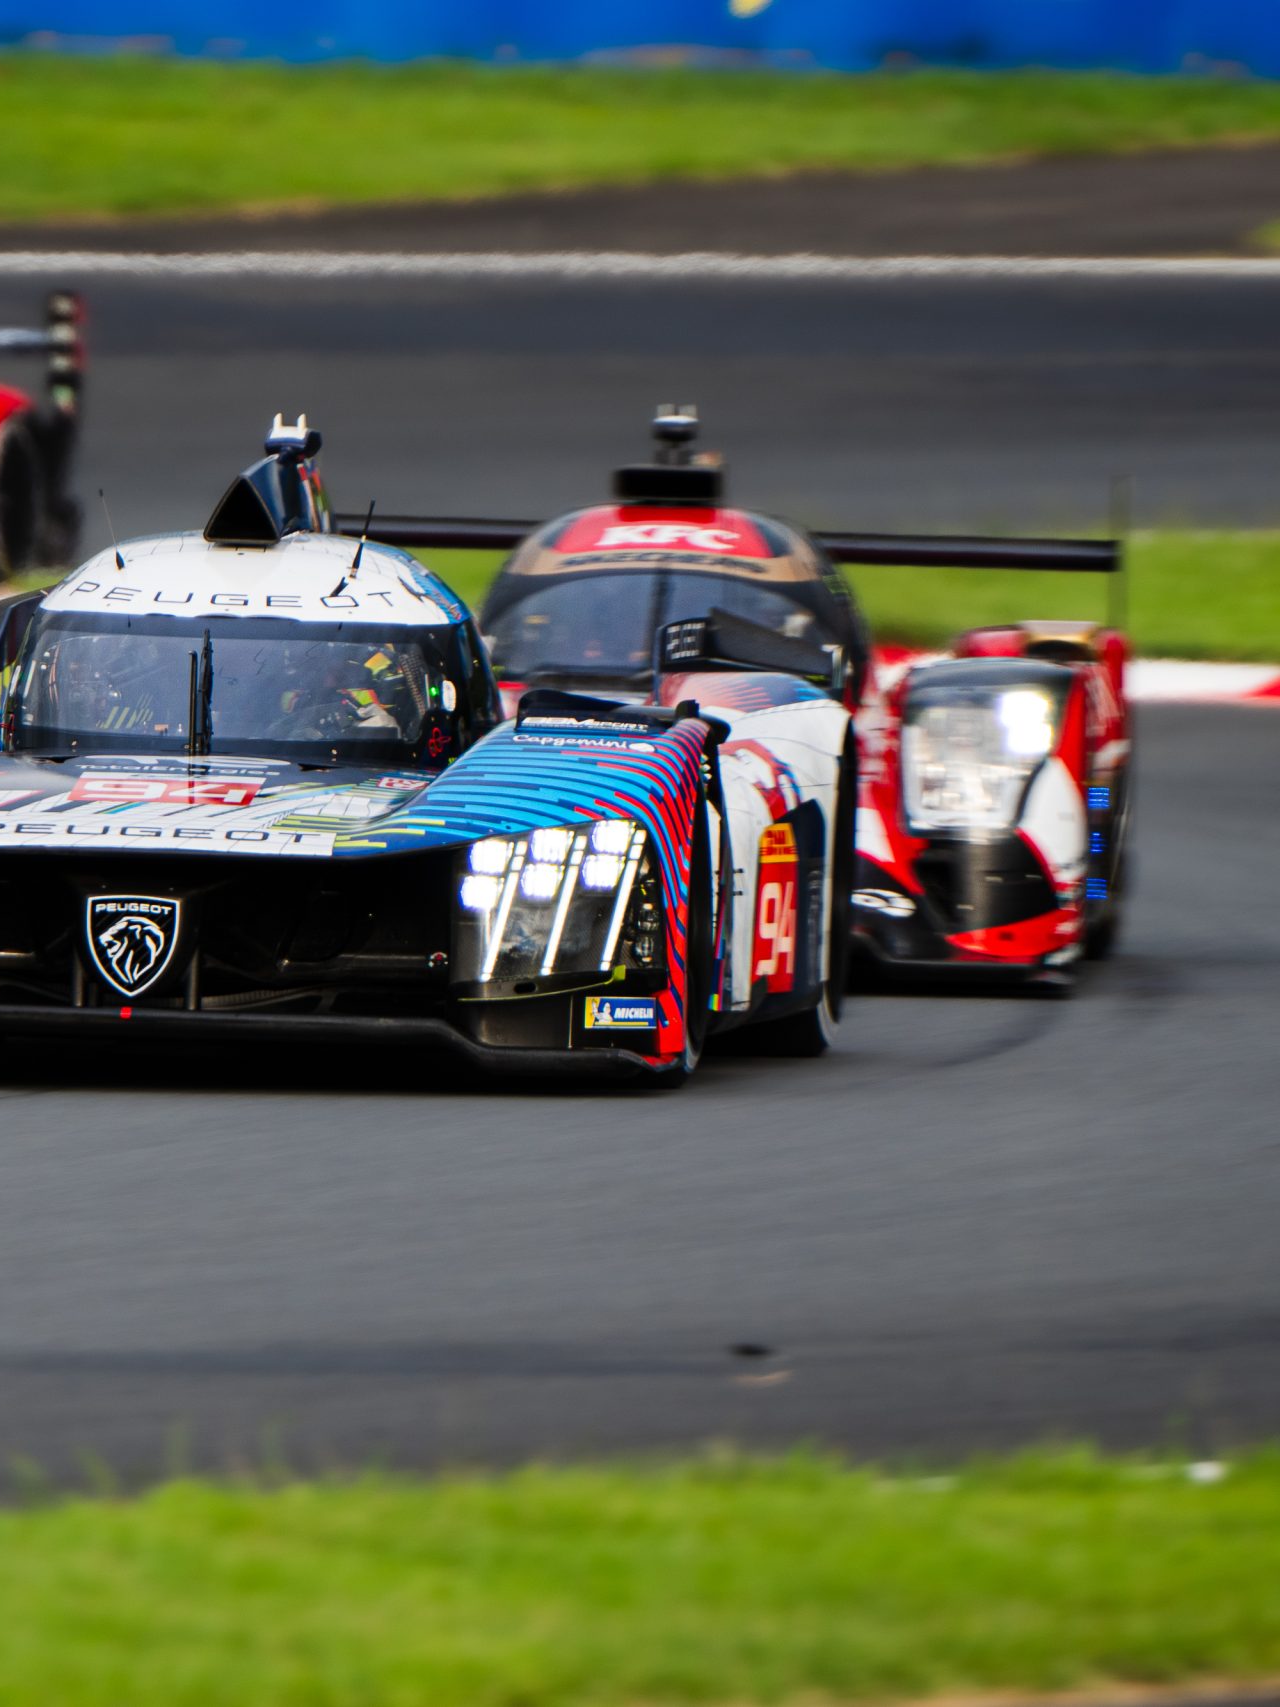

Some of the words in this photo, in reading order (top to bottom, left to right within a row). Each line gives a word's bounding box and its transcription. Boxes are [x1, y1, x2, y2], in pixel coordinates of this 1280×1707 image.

[594, 525, 740, 549] KFC
[69, 581, 394, 608] PEUGEOT
[513, 734, 626, 749] Capgemini
[75, 764, 281, 775] TotalEnergies
[82, 780, 248, 803] 94
[95, 903, 173, 915] PEUGEOT
[755, 881, 797, 976] 94
[613, 1007, 654, 1019] MICHELIN
